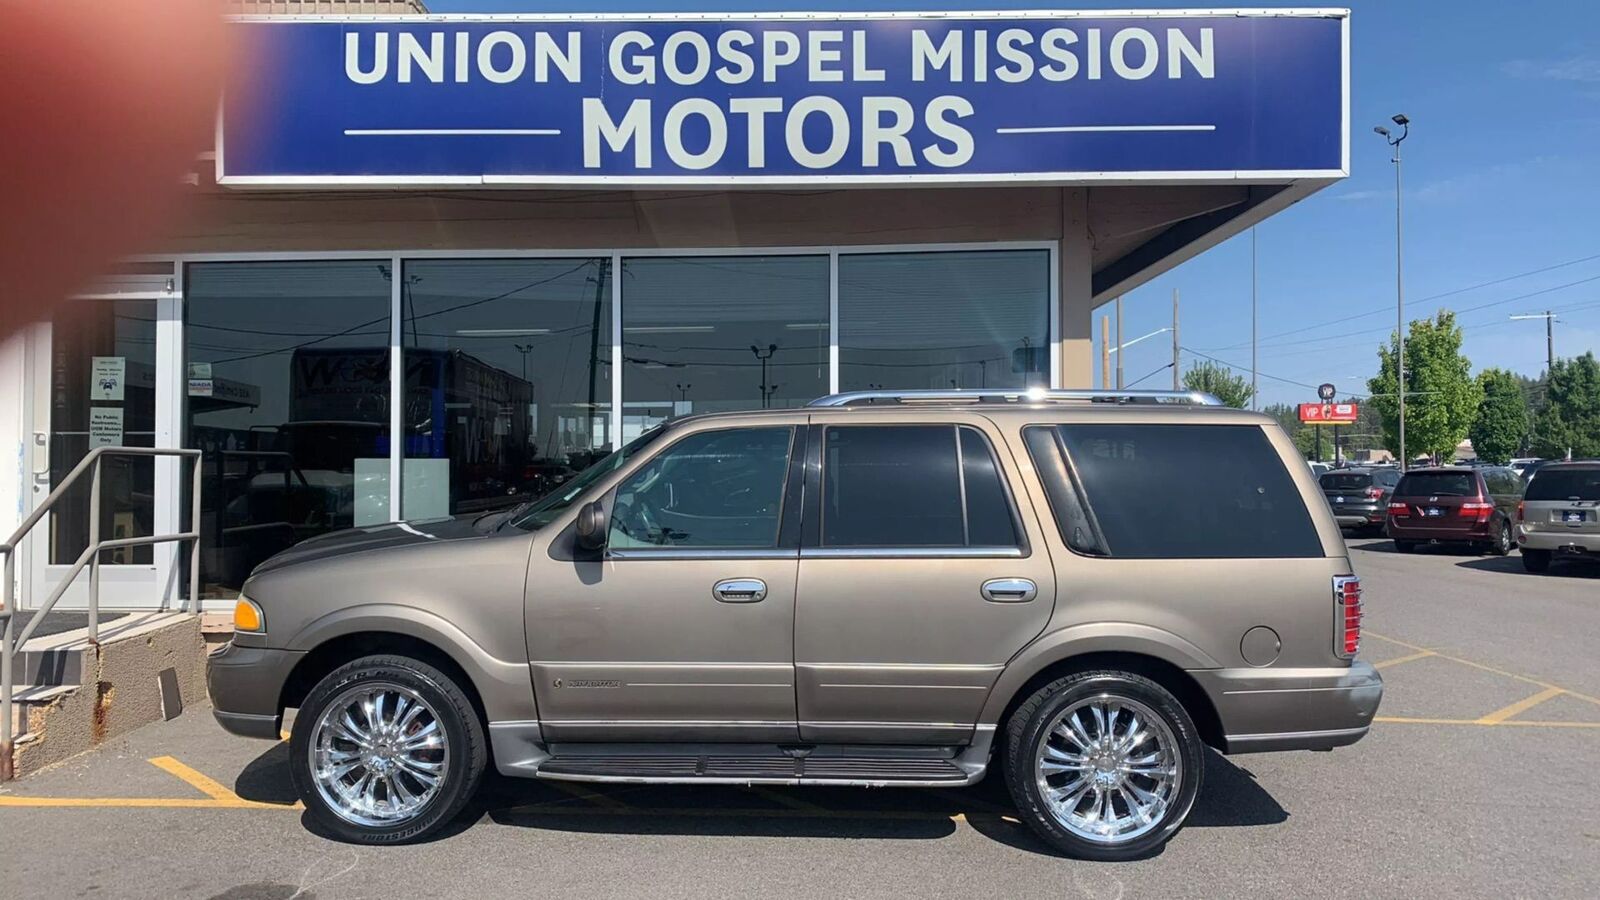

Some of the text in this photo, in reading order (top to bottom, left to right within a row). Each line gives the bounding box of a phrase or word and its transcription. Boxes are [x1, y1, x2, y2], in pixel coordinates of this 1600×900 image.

[345, 27, 1216, 86] UNION GOSPEL MISSION
[582, 95, 975, 170] MOTORS
[1305, 407, 1319, 418] VIP
